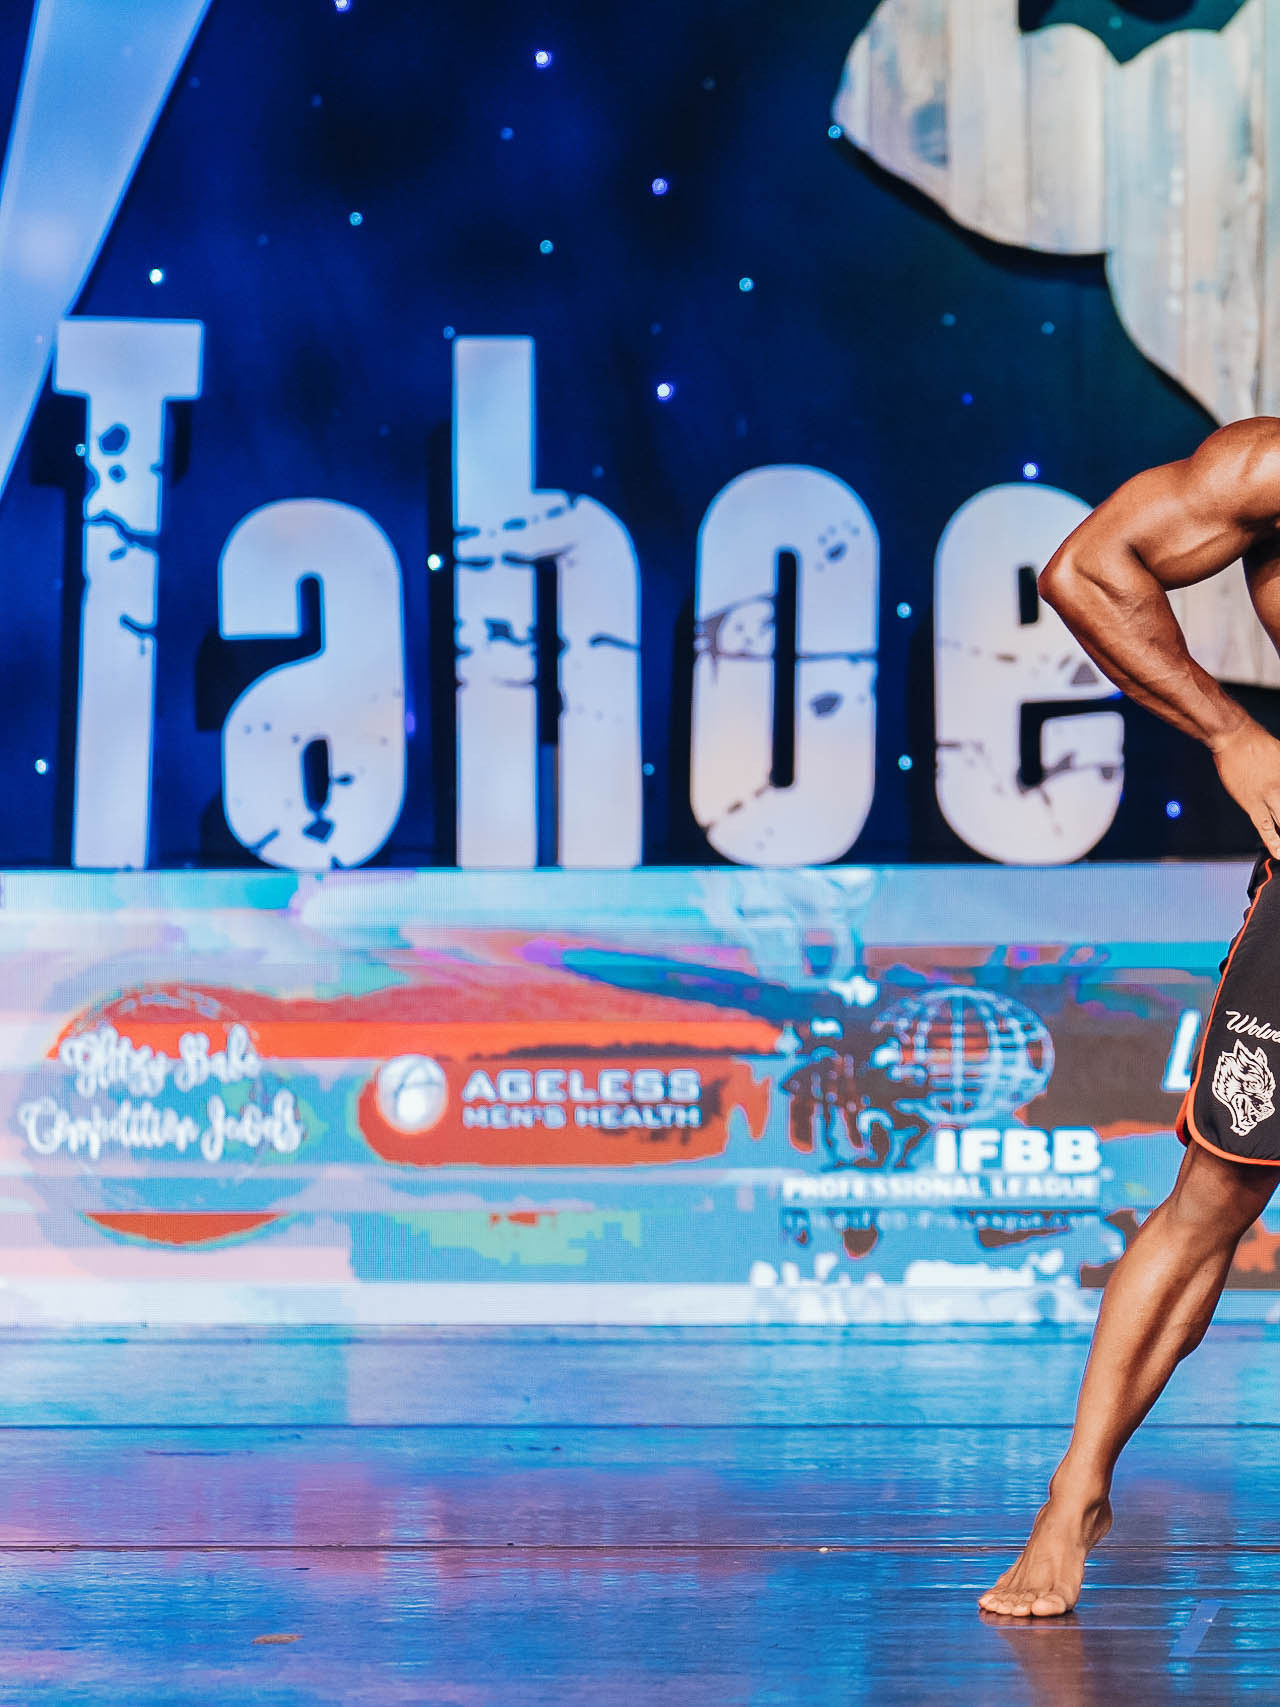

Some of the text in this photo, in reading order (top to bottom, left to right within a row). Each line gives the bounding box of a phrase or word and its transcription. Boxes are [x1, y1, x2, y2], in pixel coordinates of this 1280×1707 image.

[54, 318, 1125, 868] Tahoe
[462, 1069, 700, 1103] AGELESS
[17, 1097, 199, 1160] Competition
[463, 1105, 702, 1129] MEN'S HEALTH
[934, 1128, 1102, 1174] IFBB
[783, 1176, 1100, 1200] PROFESSIONAL LEAGUE
